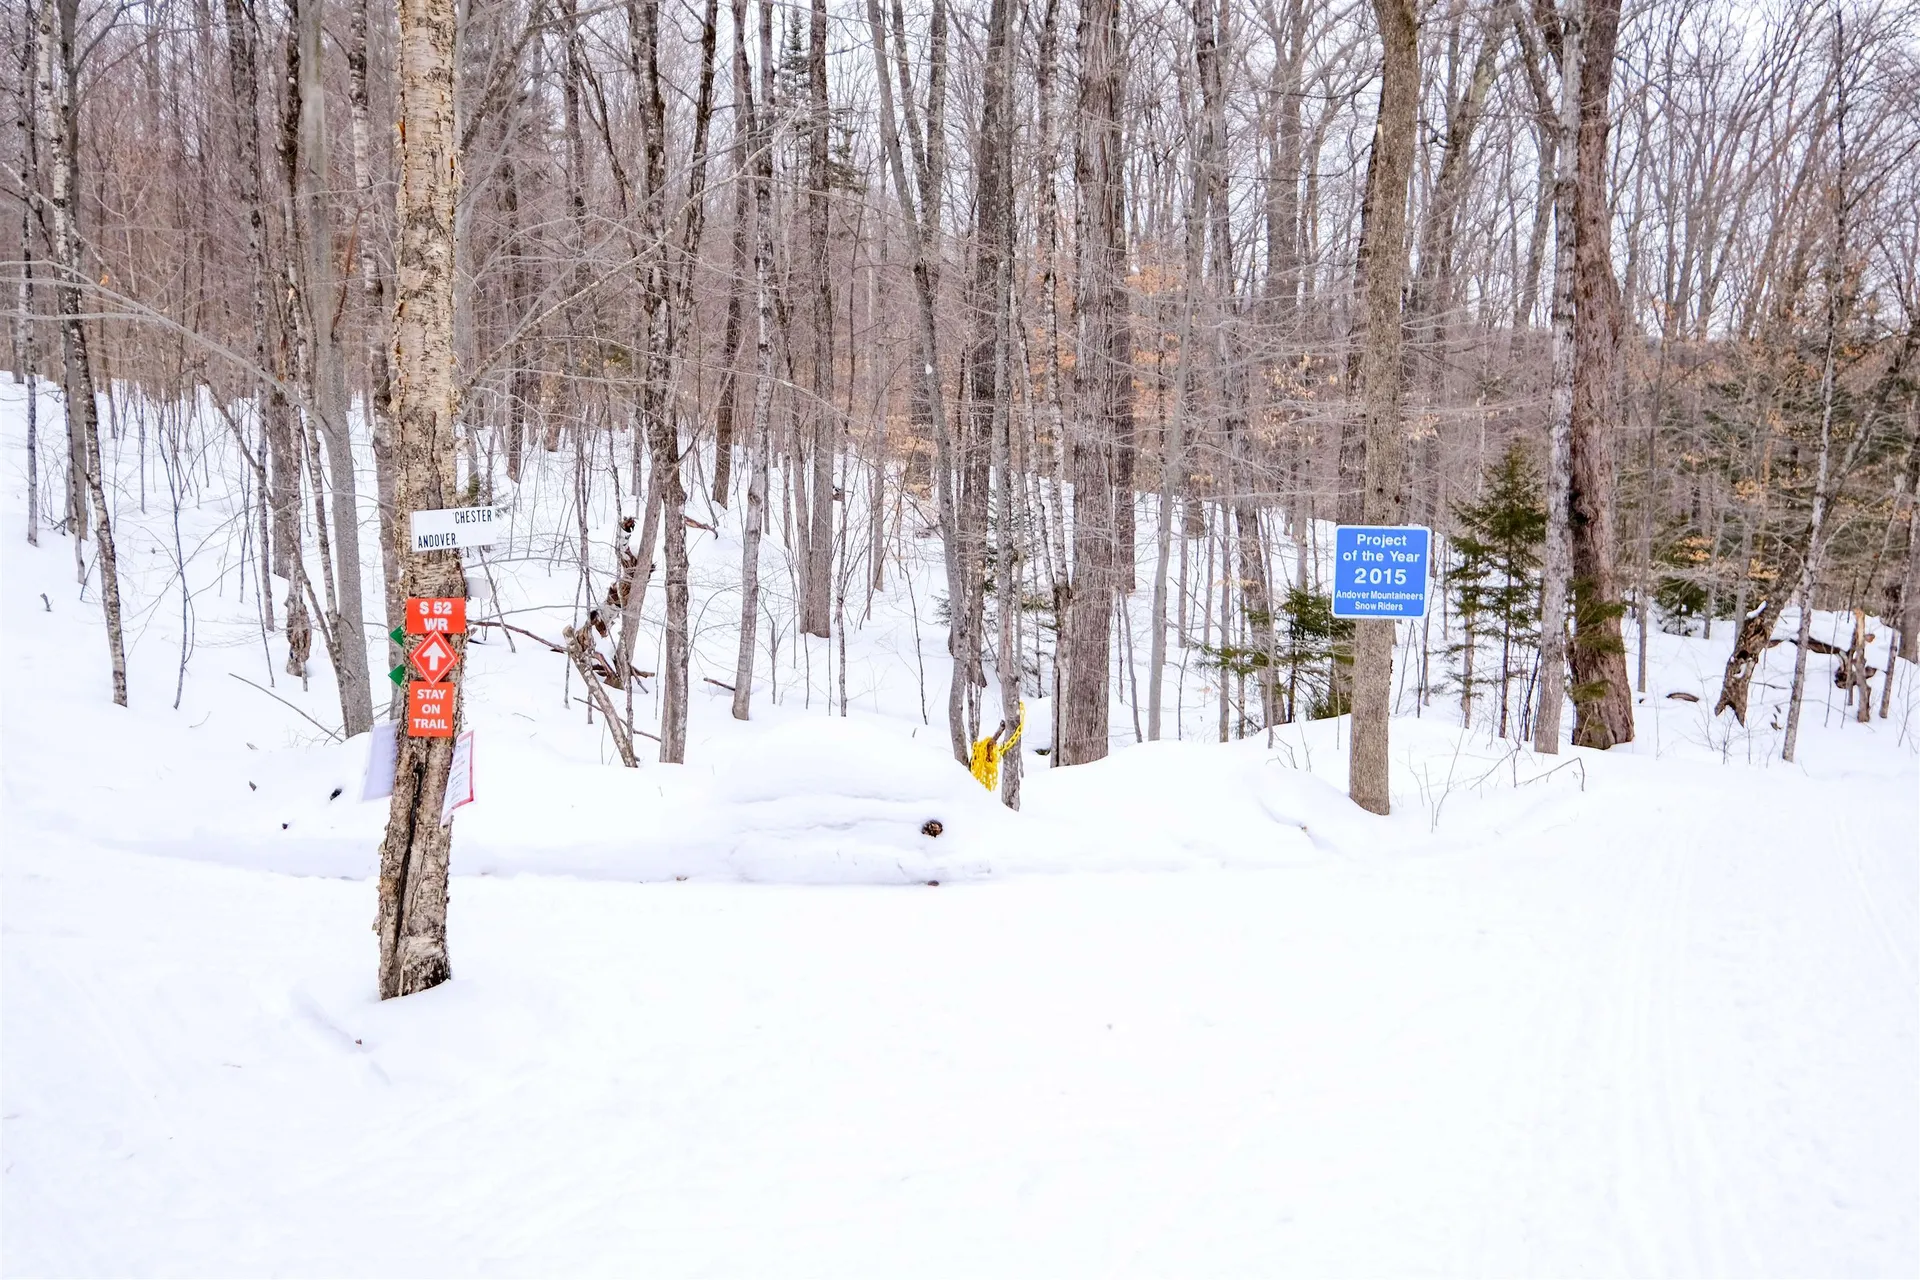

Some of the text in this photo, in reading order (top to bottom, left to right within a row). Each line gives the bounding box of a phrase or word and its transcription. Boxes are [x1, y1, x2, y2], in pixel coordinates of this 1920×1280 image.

[454, 510, 492, 524] CHESTER
[418, 532, 456, 548] ANDOVER
[1357, 534, 1407, 548] Project
[1343, 550, 1420, 562] of the Year
[1354, 568, 1406, 584] 2015
[1336, 590, 1424, 600] Andover Mountaineers
[420, 602, 452, 614] S 52
[1354, 601, 1403, 611] Snow Riders
[424, 618, 448, 631] WR
[417, 689, 446, 700] STAY
[422, 704, 440, 714] ON
[414, 718, 448, 729] TRAIL
